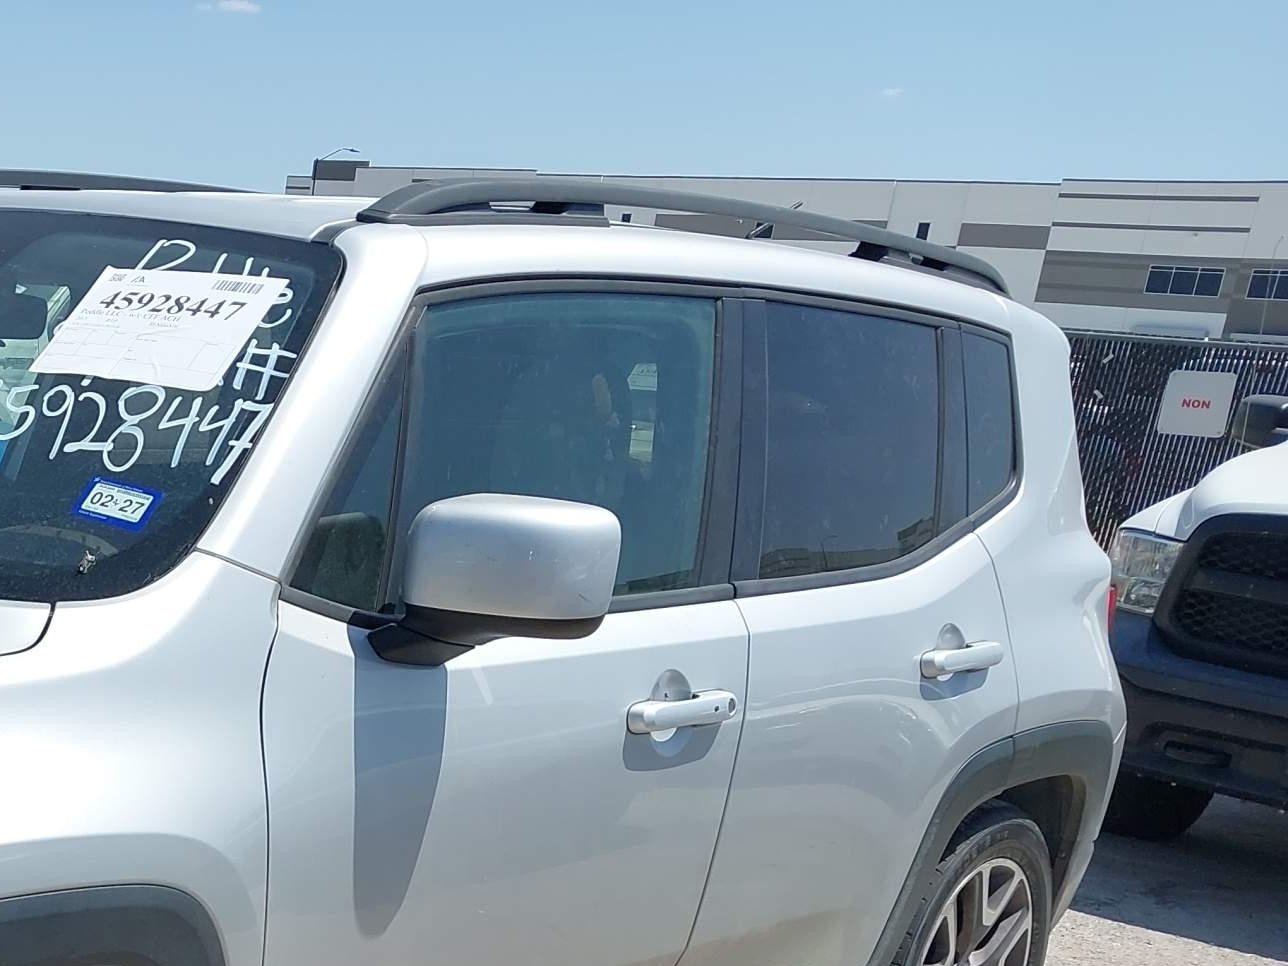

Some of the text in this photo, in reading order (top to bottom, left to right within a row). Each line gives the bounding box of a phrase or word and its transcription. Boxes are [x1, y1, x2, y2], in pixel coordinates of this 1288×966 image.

[100, 290, 248, 321] 45928447
[1181, 398, 1211, 409] NON
[90, 491, 114, 508] 02
[118, 498, 145, 515] 27
